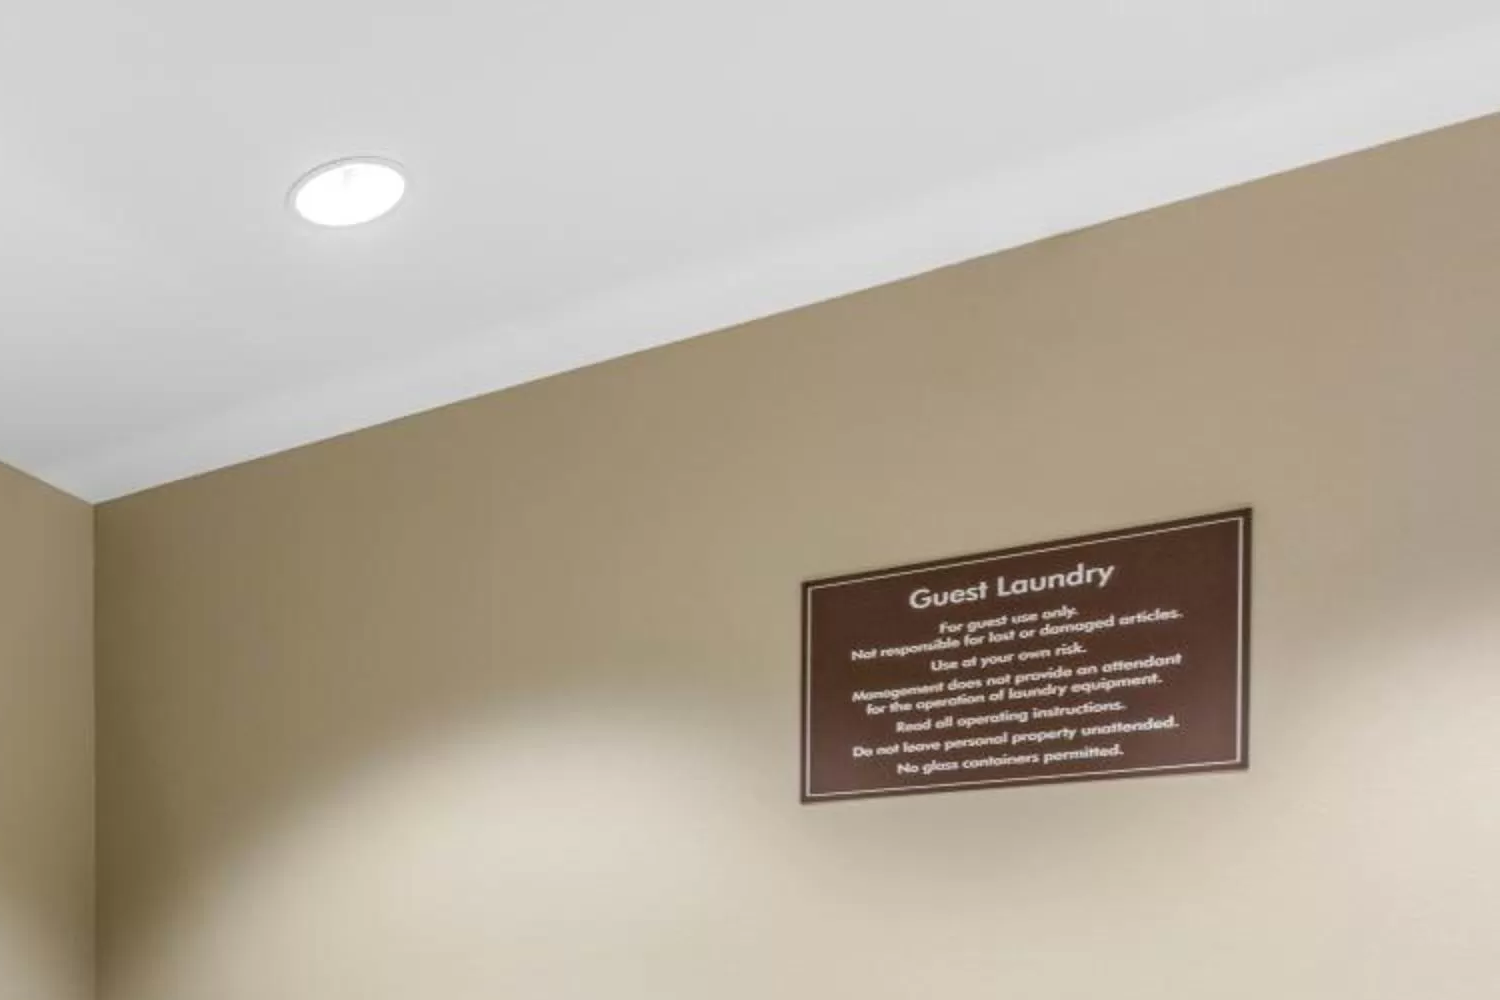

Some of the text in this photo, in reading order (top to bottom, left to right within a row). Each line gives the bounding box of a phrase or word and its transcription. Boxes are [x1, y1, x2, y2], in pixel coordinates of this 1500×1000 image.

[909, 562, 1115, 609] Guest Laundry
[852, 608, 1184, 661] Not responsible for lost or damaged articles.
[939, 604, 1079, 633] For guest use only.
[852, 652, 1183, 702] Management does not provide an attendant
[931, 641, 1088, 671] Use at your own risk.
[866, 673, 1163, 715] for the operation of laundry equipment.
[852, 714, 1180, 757] Do not leave personal property unattended.
[896, 701, 1127, 732] Read all operating instructions.
[896, 743, 1124, 775] No glass containers permitted.
